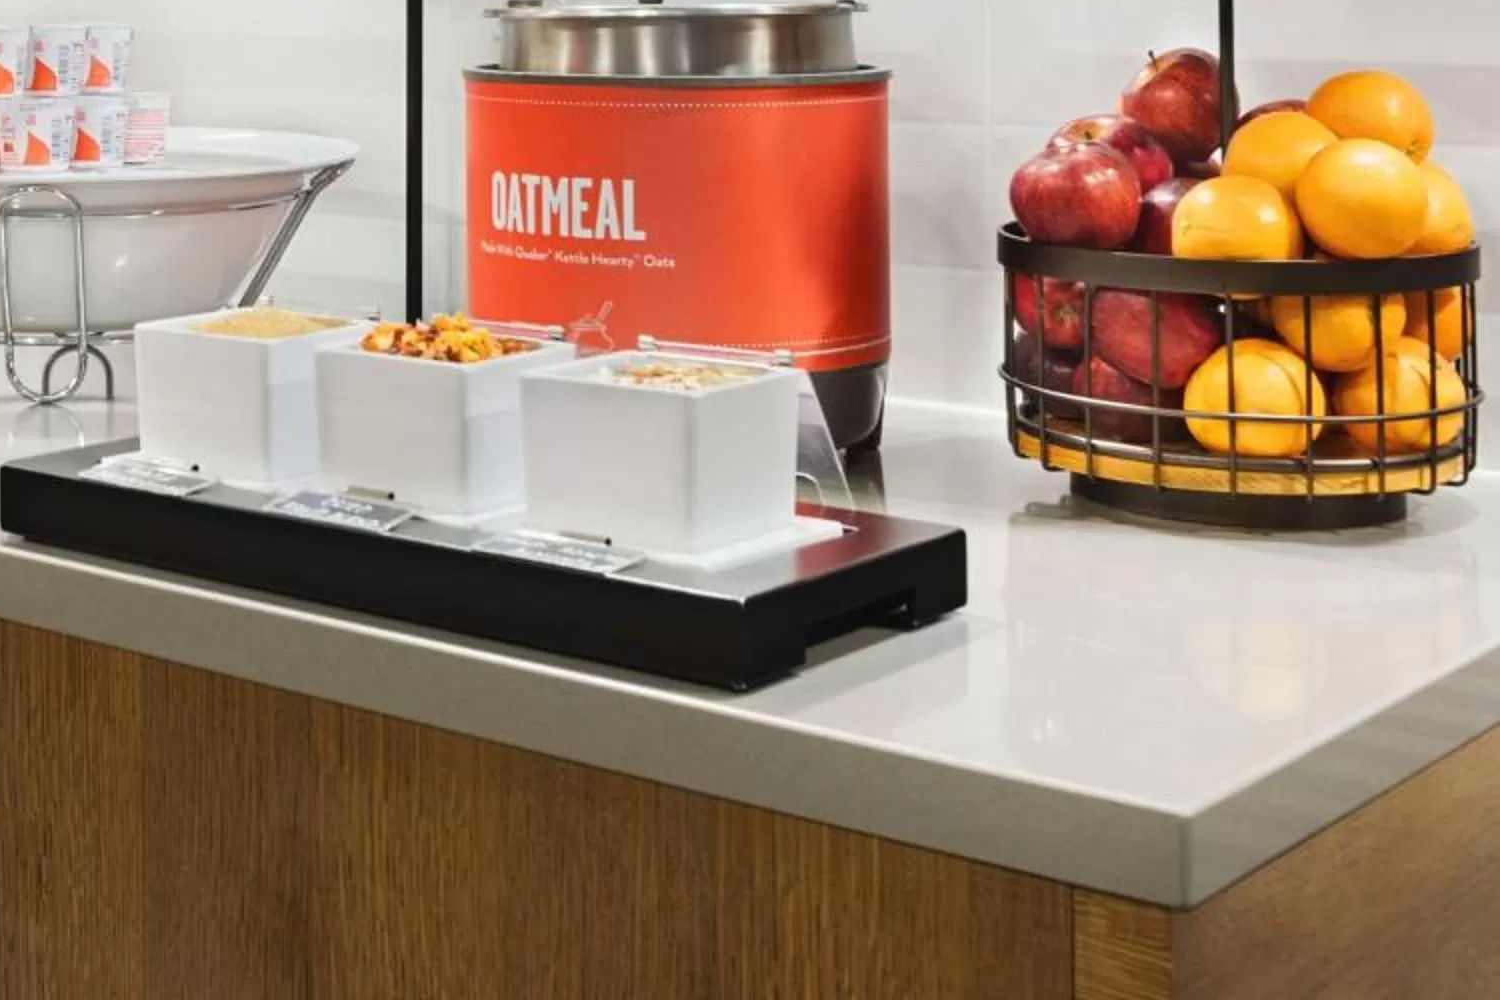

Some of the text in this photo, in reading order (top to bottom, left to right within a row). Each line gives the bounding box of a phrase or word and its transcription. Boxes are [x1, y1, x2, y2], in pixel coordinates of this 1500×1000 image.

[491, 171, 646, 241] OATMEAL
[555, 251, 589, 265] Kettle
[643, 254, 677, 269] Oats
